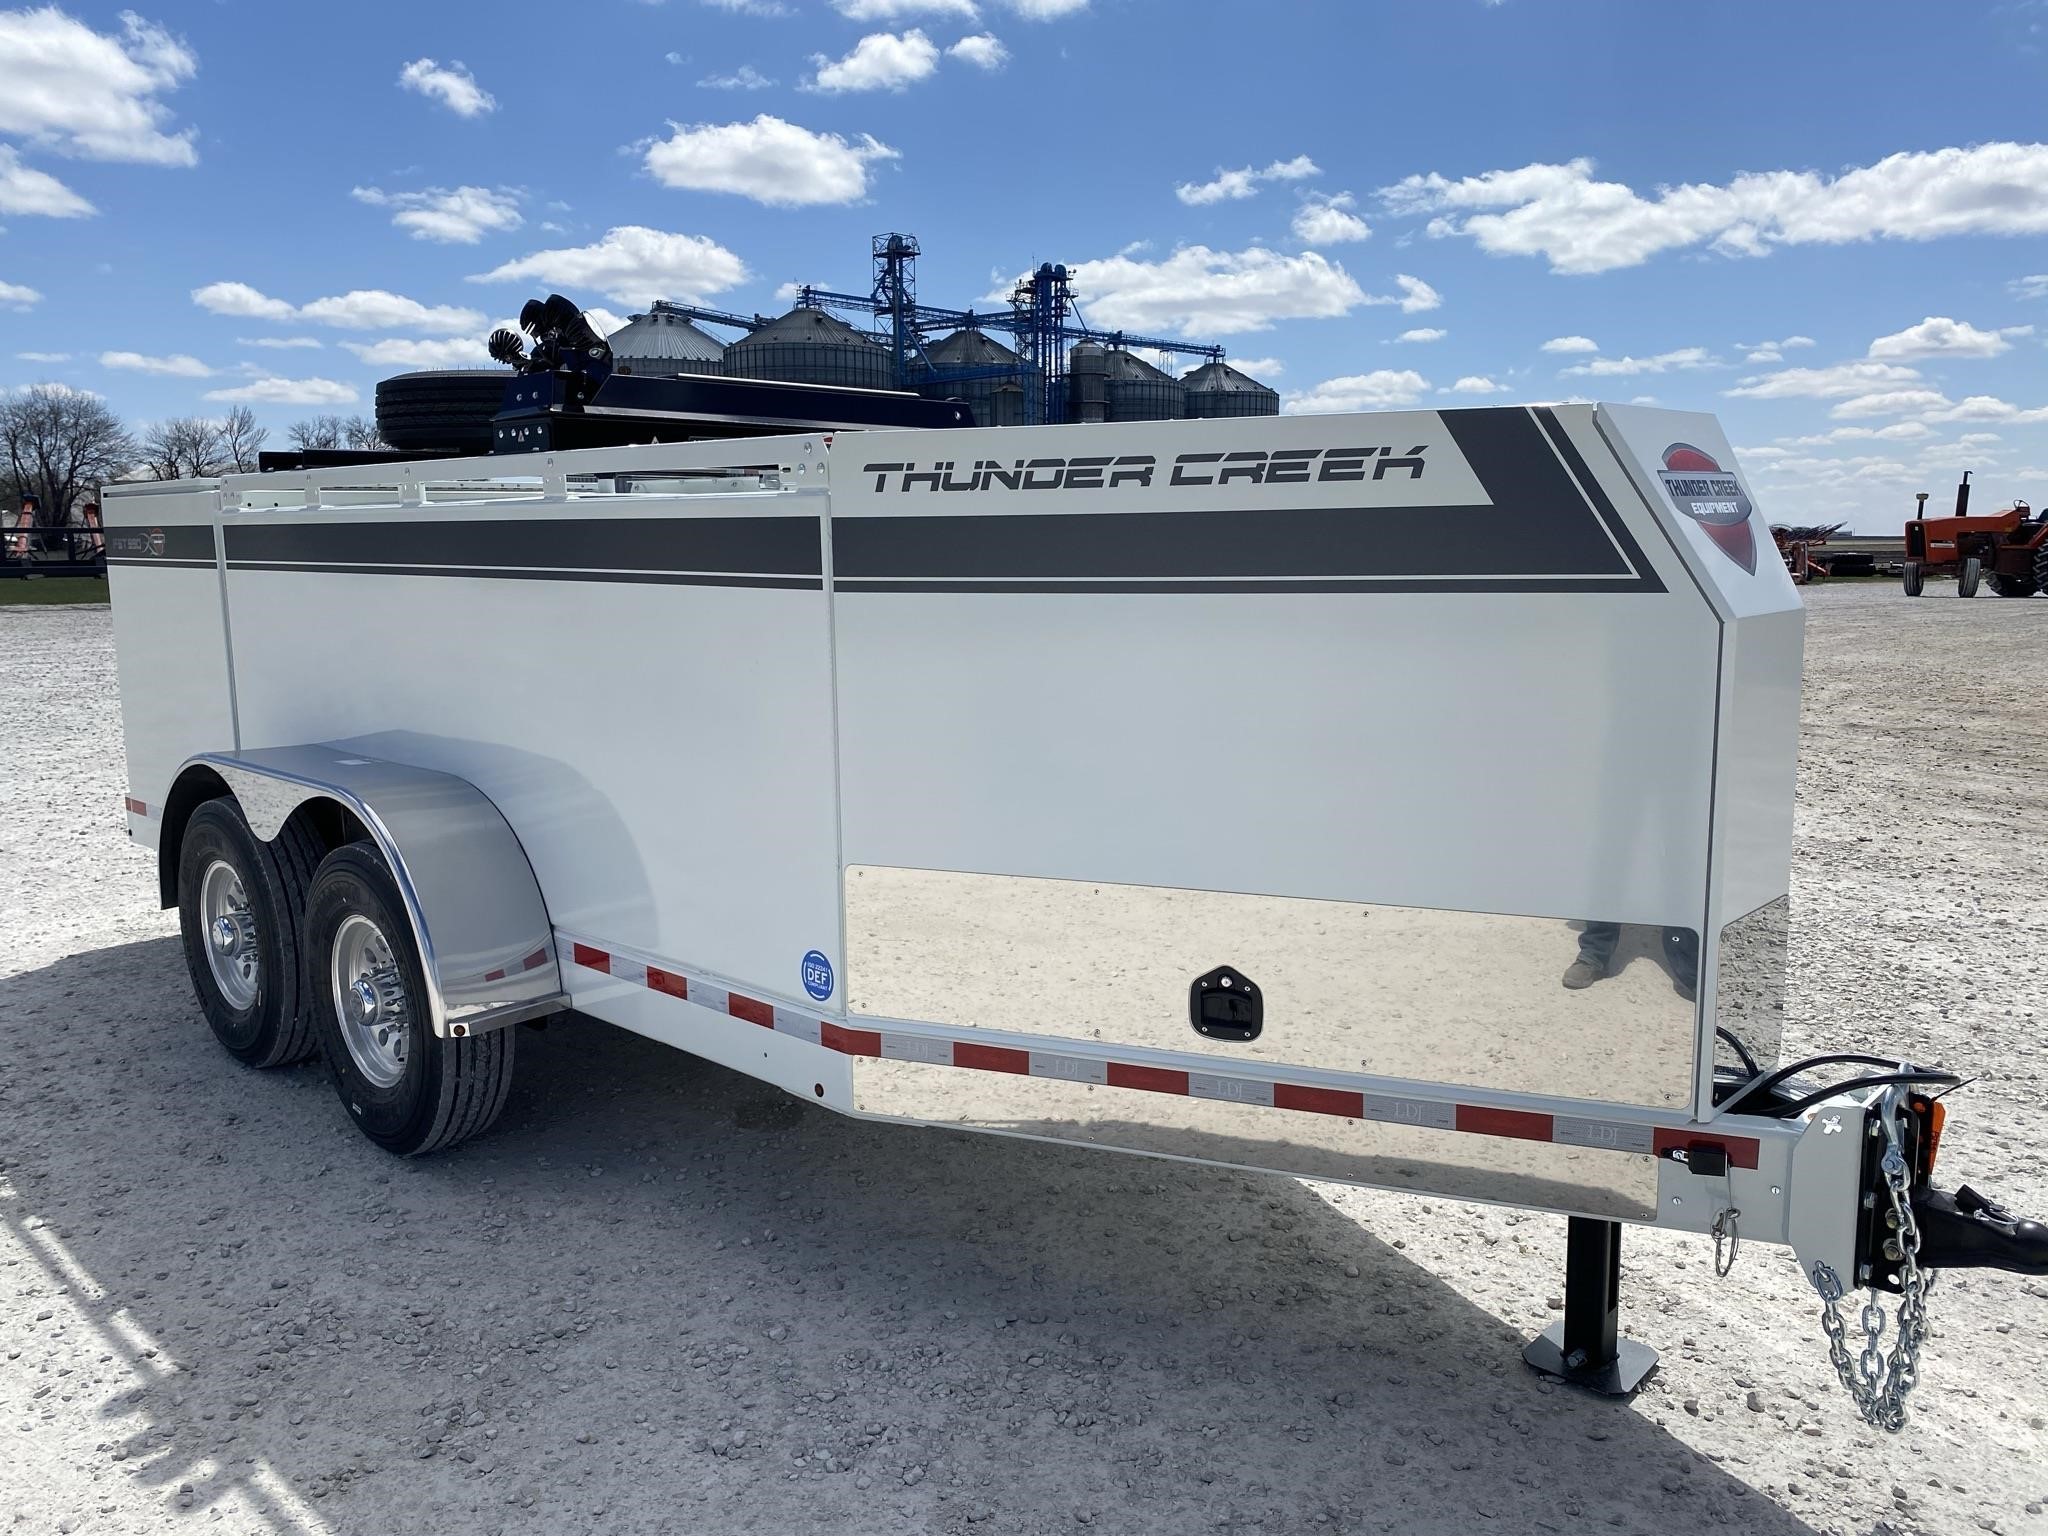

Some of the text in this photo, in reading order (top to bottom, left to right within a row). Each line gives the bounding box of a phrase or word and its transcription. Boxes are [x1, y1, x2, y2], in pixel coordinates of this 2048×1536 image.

[863, 445, 1429, 492] THUNDER CREEK
[1665, 480, 1744, 496] THUNDER CREEK
[1690, 502, 1738, 515] EQUIPMENT
[807, 968, 828, 984] DEF
